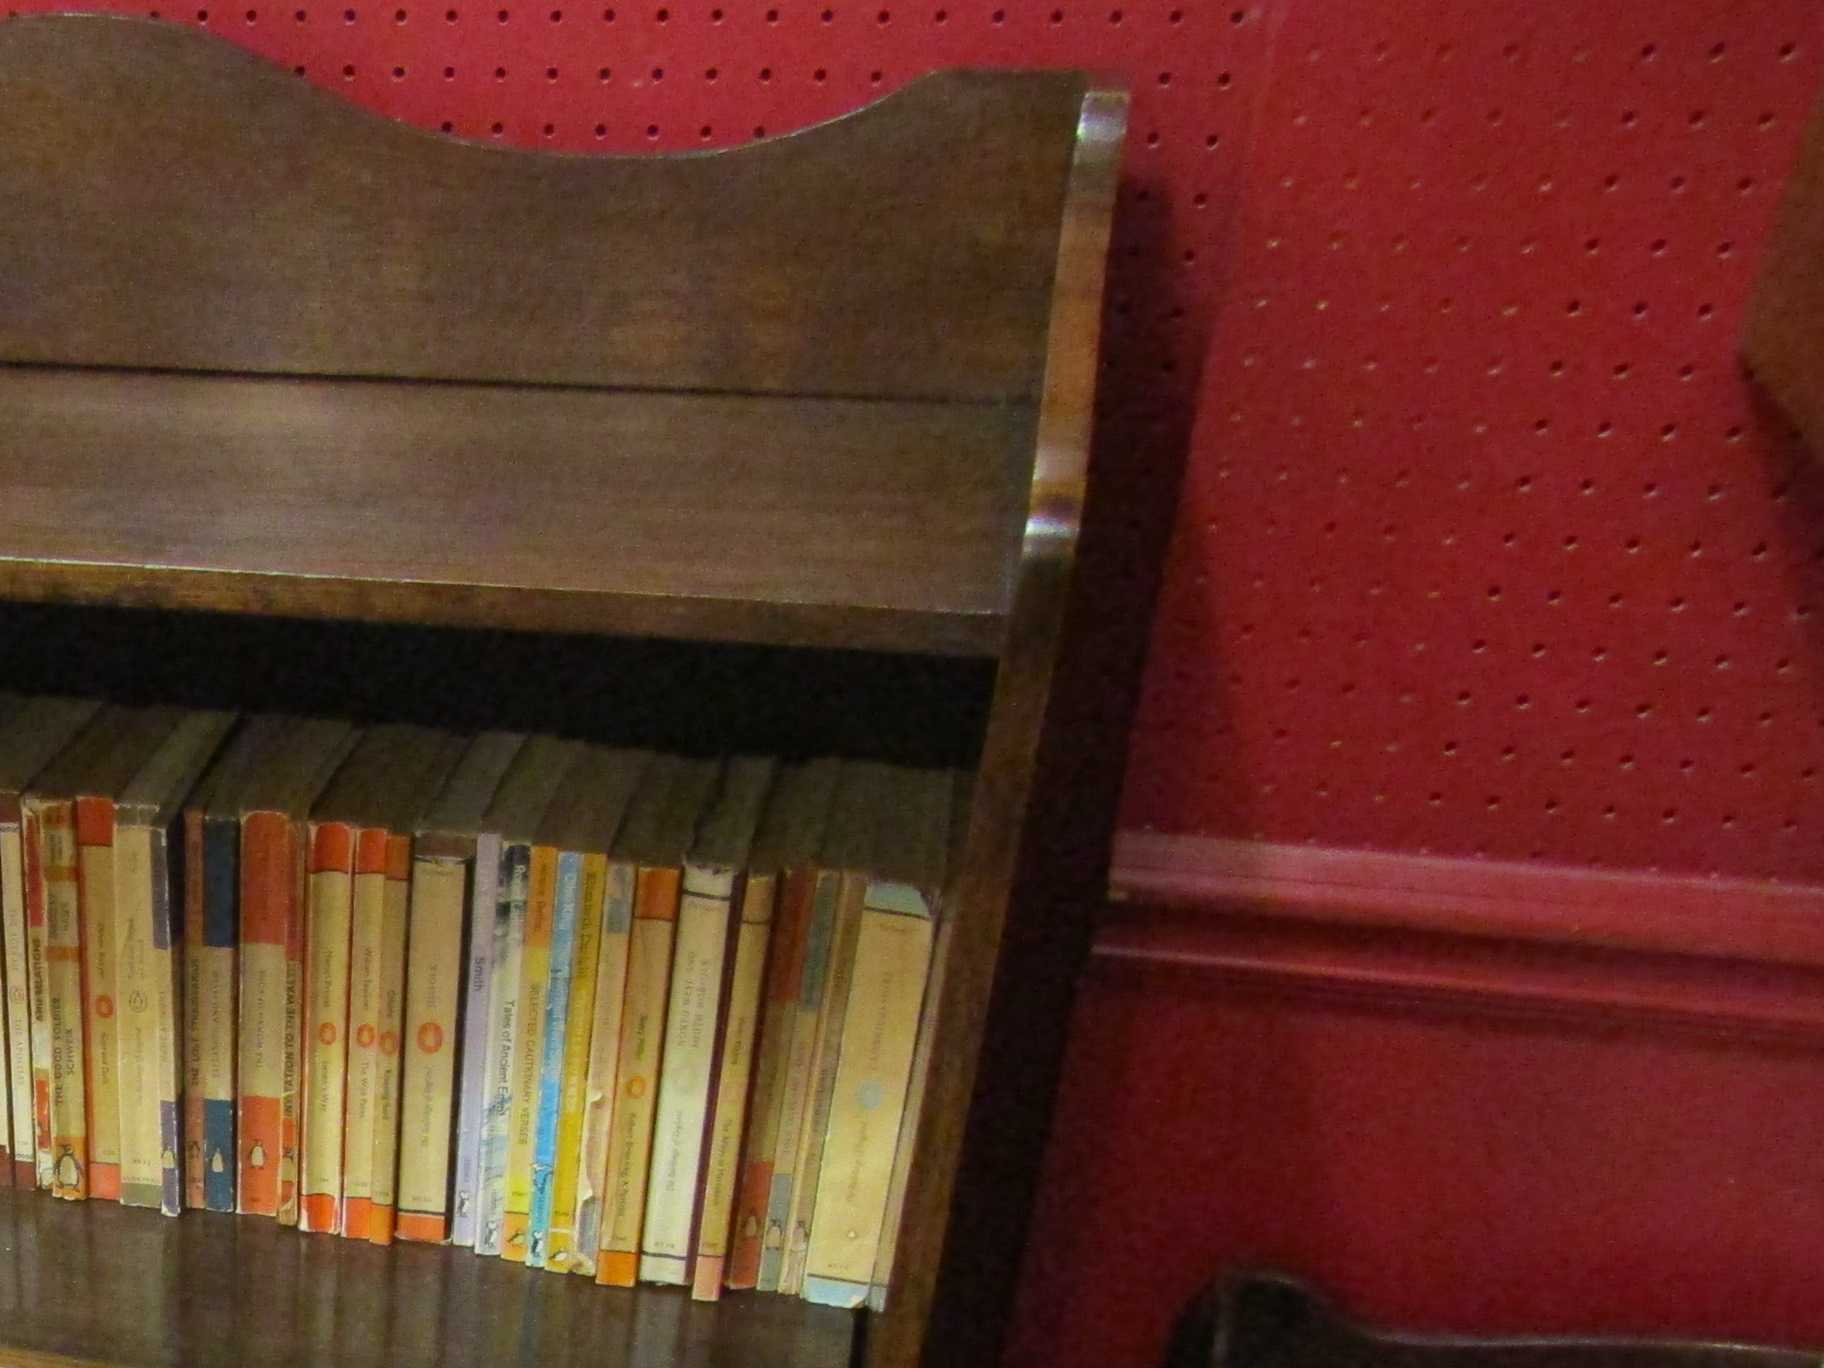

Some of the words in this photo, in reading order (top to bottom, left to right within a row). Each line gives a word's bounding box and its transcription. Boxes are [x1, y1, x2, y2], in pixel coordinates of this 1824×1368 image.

[472, 957, 488, 992] Smith
[50, 996, 64, 1040] SOLDIER
[286, 1006, 297, 1029] THE
[502, 1000, 514, 1029] Tales
[525, 984, 537, 1036] SELECTED
[285, 1032, 295, 1047] TO
[501, 1032, 512, 1043] of
[52, 1046, 65, 1079] GOOD
[497, 1045, 510, 1084] Ancient
[53, 1084, 65, 1104] THE
[518, 1107, 529, 1145] VERSES
